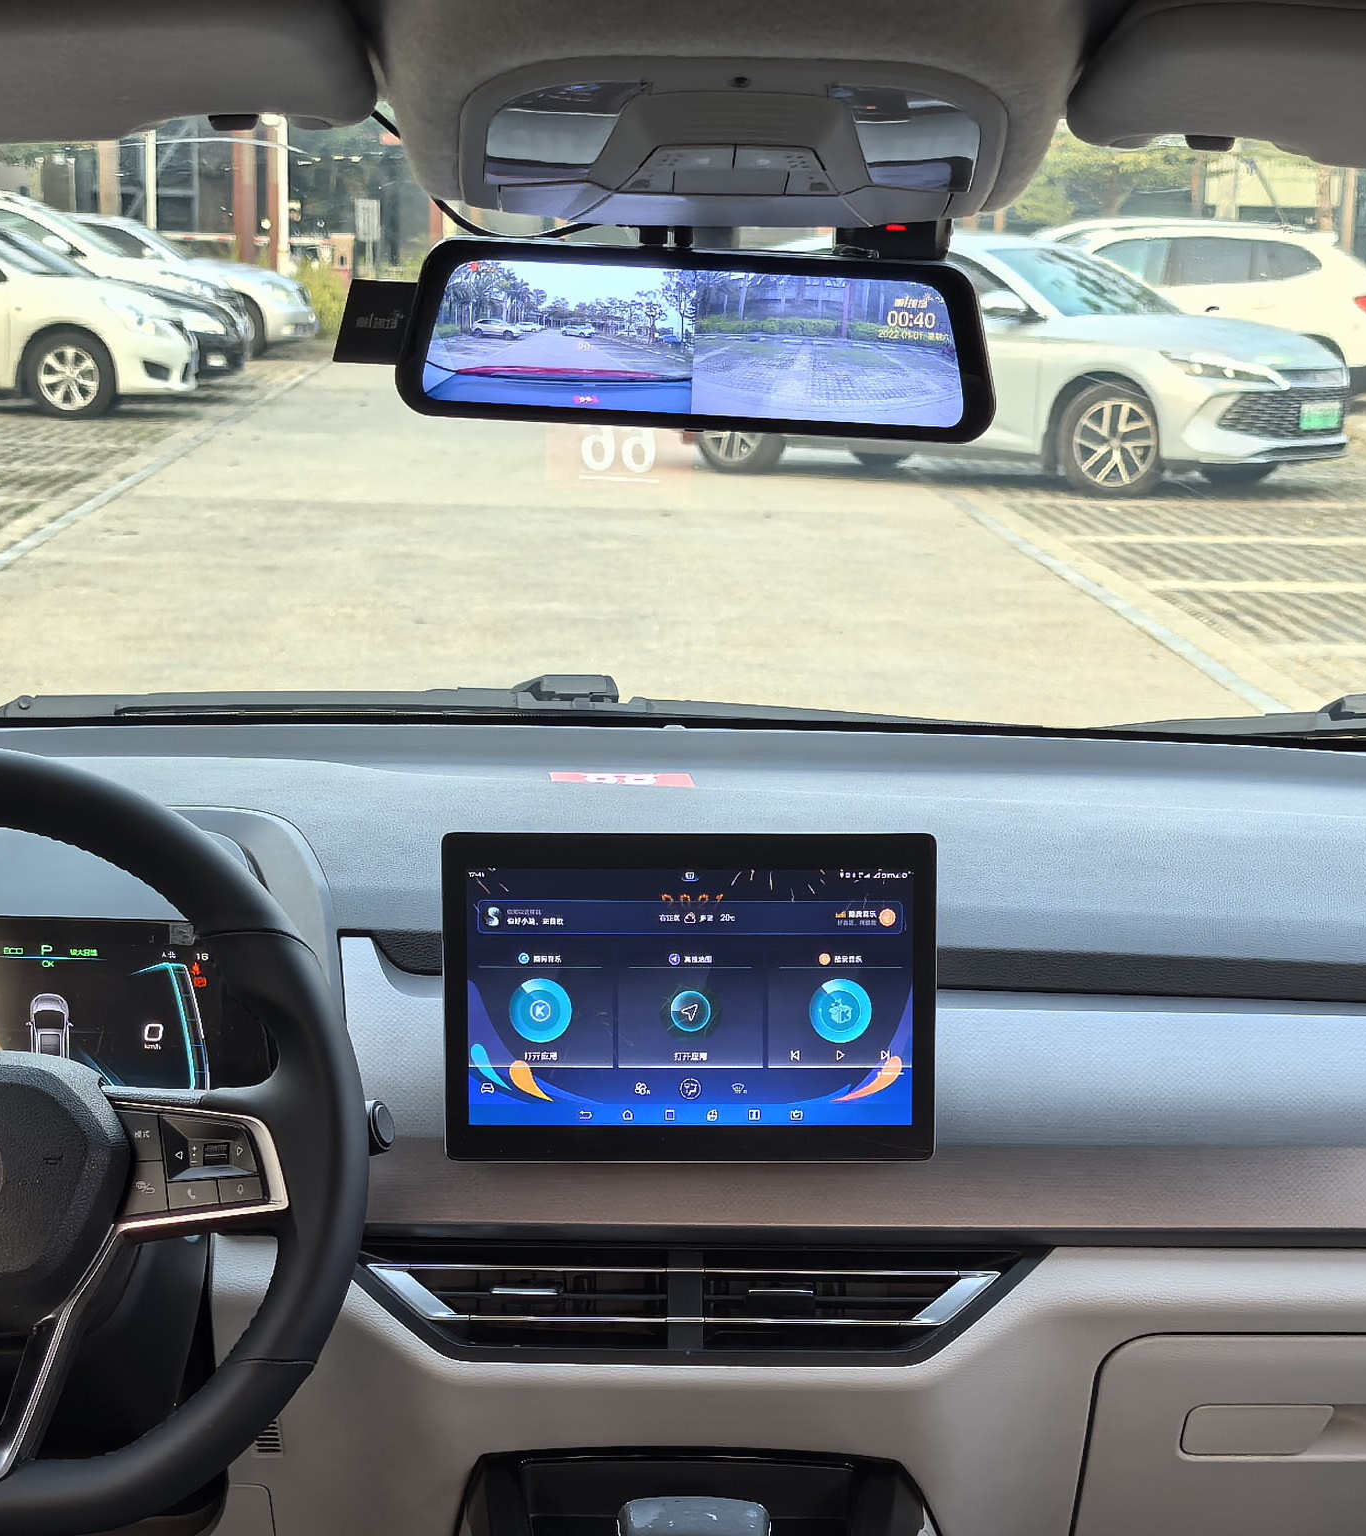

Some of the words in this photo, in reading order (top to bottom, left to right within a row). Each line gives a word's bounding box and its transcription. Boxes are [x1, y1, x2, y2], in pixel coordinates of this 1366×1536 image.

[887, 310, 936, 329] 00:40
[40, 945, 53, 956] P
[41, 959, 55, 968] OK
[144, 1023, 164, 1042] 0
